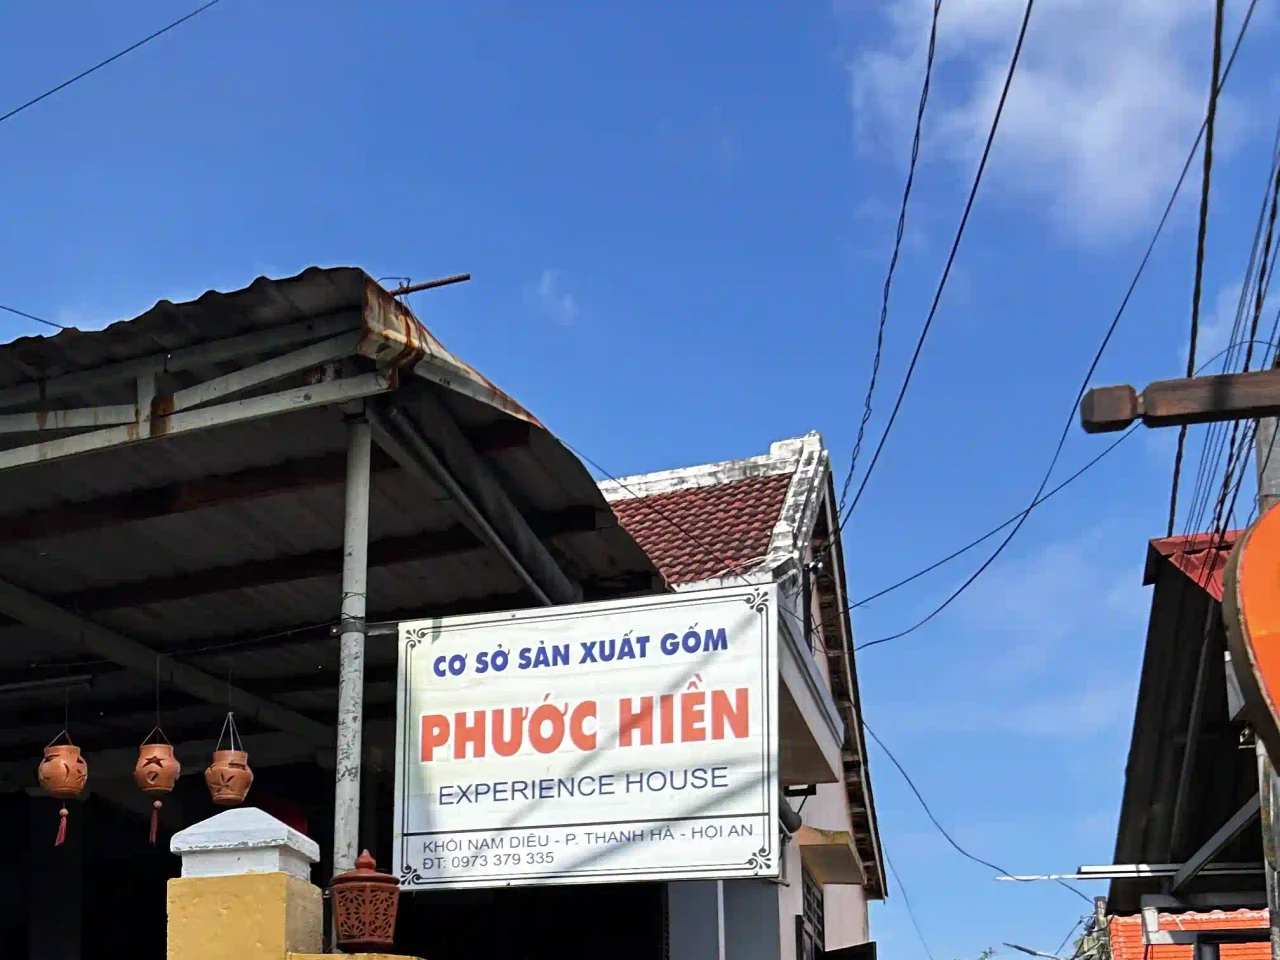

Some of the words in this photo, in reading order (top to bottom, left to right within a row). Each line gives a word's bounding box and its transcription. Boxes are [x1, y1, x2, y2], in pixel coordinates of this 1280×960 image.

[433, 653, 468, 678] CƠ
[475, 644, 511, 673] SỞ
[518, 640, 570, 670] SẢN
[579, 629, 651, 665] XUẤT
[660, 622, 728, 654] GỐM
[421, 693, 597, 762] PHƯỚC
[619, 673, 750, 747] HIỀN
[438, 774, 615, 806] EXPERIENCE
[626, 766, 729, 793] HOUSE
[467, 837, 504, 851] NAM
[584, 830, 644, 844] THANH
[650, 825, 675, 841] HÀ
[727, 824, 753, 837] AN
[423, 857, 447, 869] ĐT:
[451, 855, 488, 869] 0973
[493, 853, 521, 866] 379
[526, 851, 555, 865] 335
